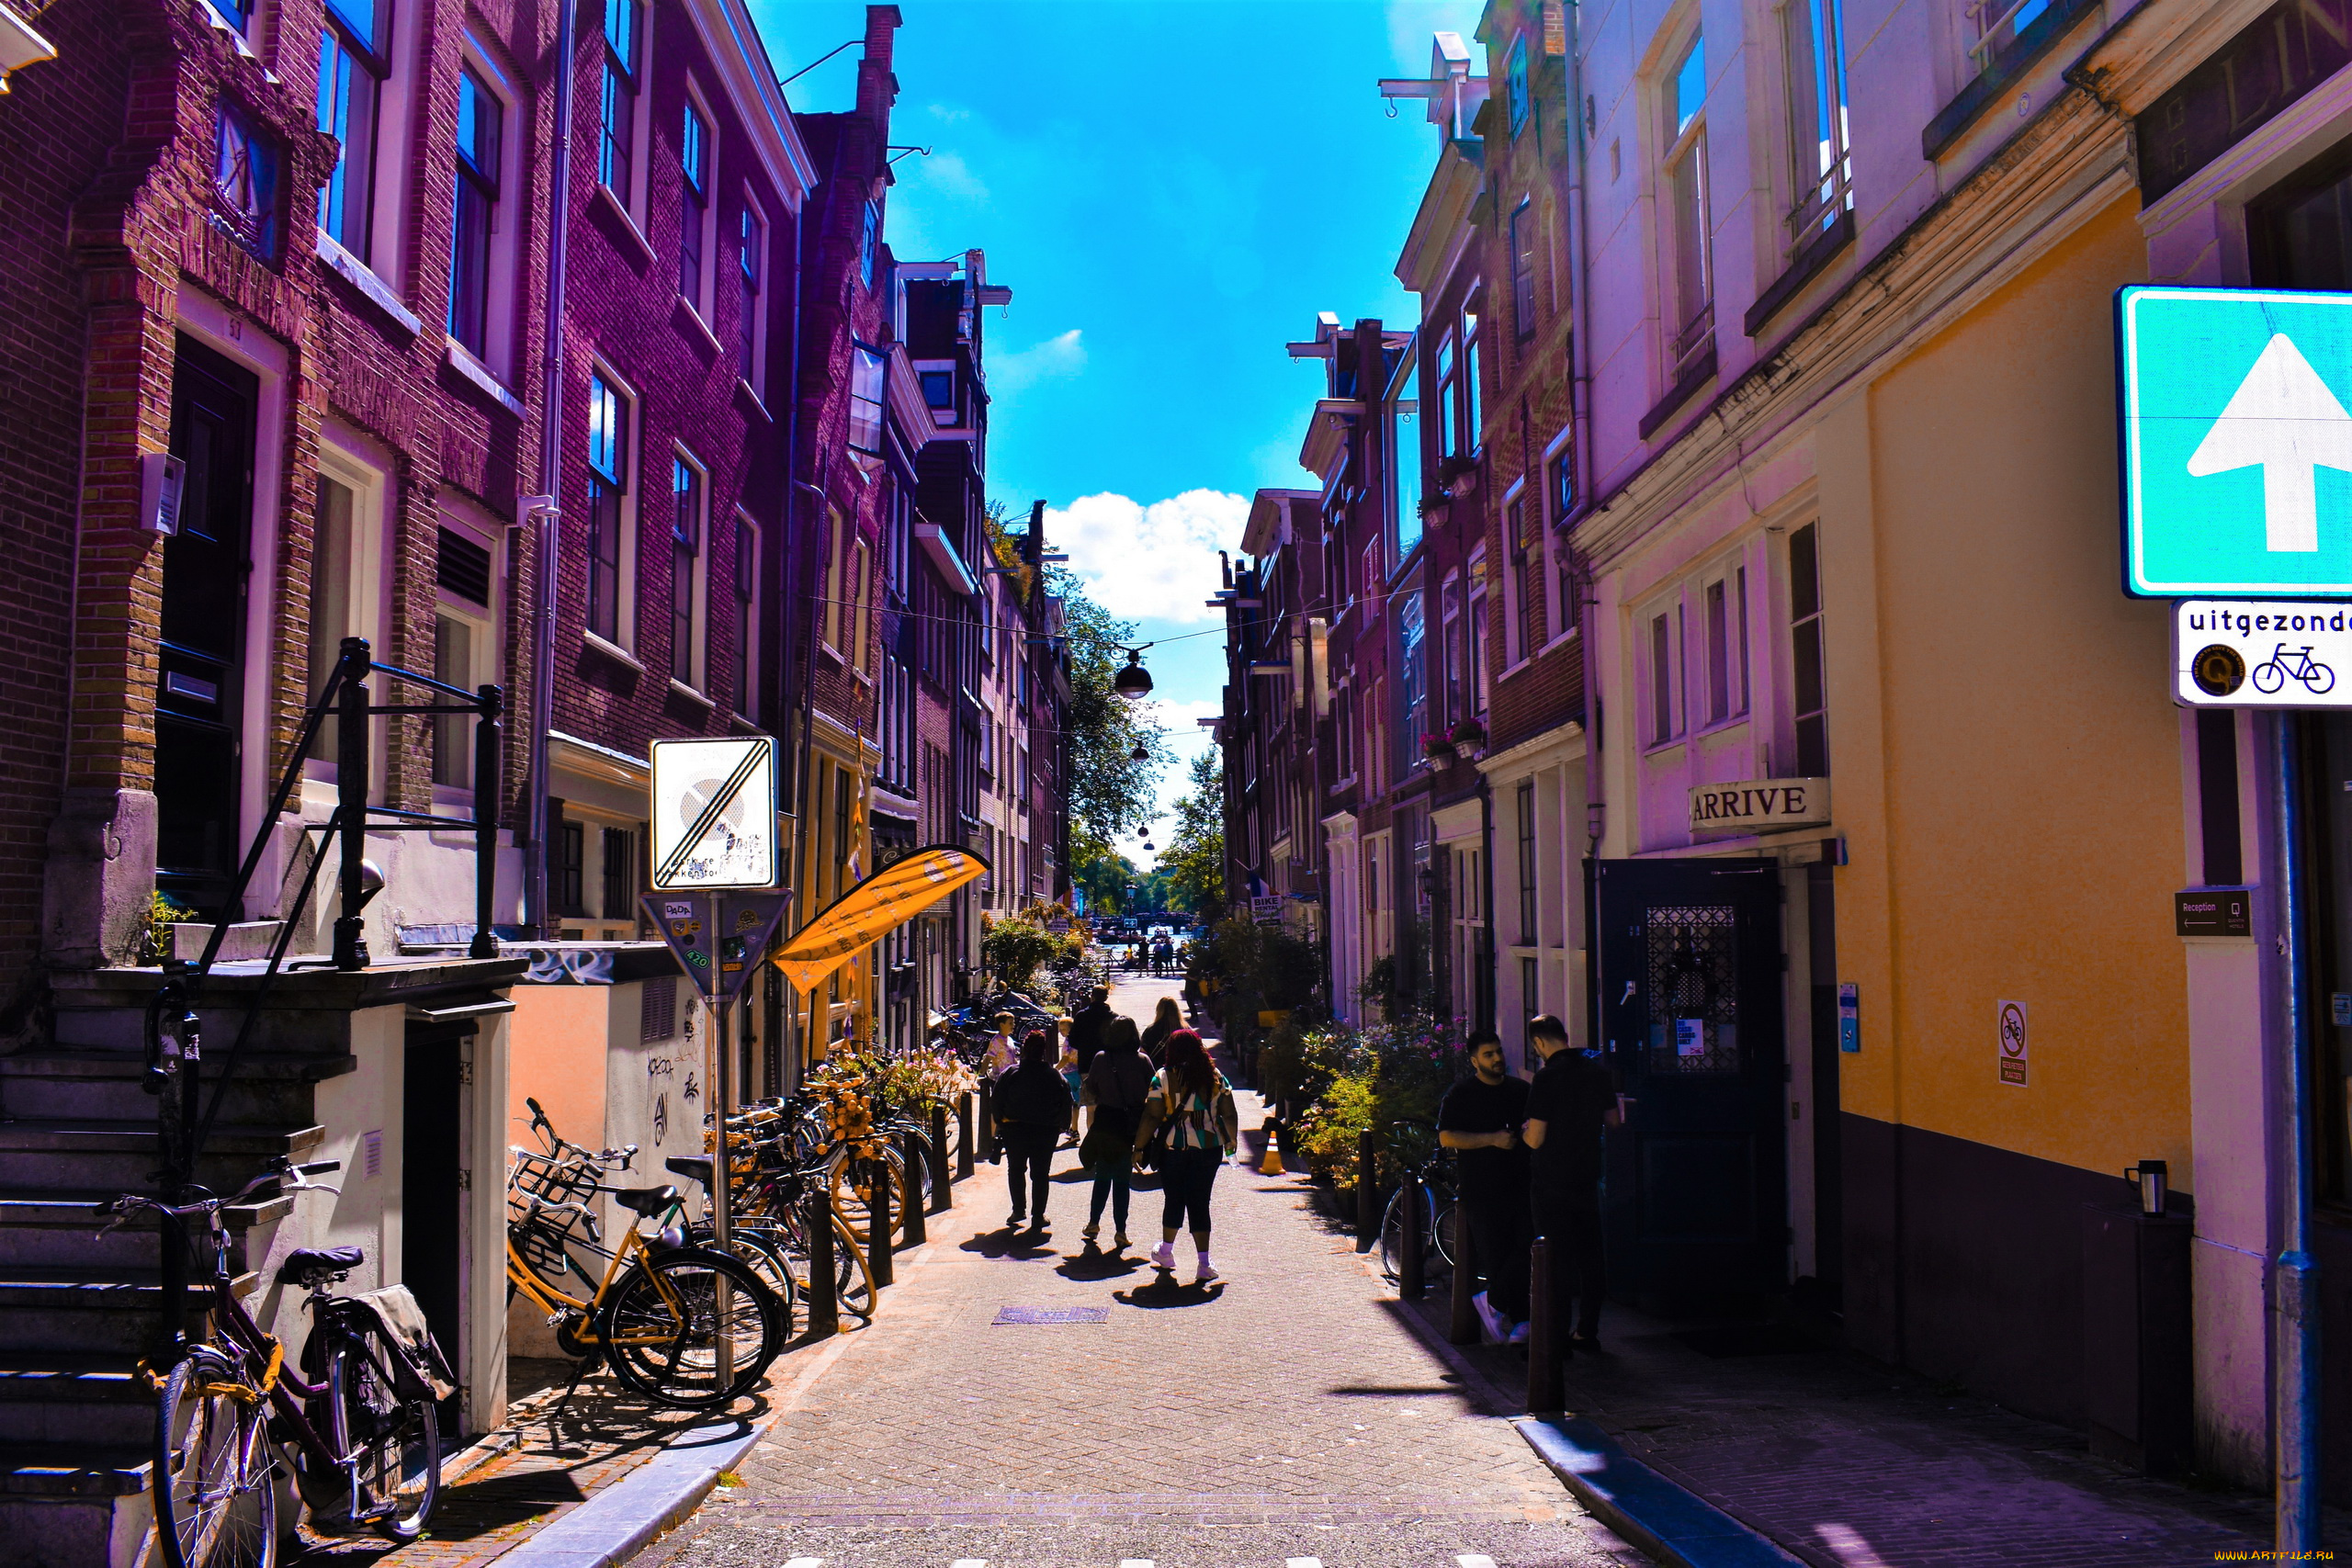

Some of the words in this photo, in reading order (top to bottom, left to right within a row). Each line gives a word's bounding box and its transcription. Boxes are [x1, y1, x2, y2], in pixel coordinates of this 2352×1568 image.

[2190, 609, 2352, 638] uitgezond
[1693, 786, 1807, 821] ARRIVE
[1254, 897, 1279, 906] BIKE
[2183, 902, 2216, 914] Reception
[666, 905, 691, 915] DADA
[686, 951, 707, 967] 420
